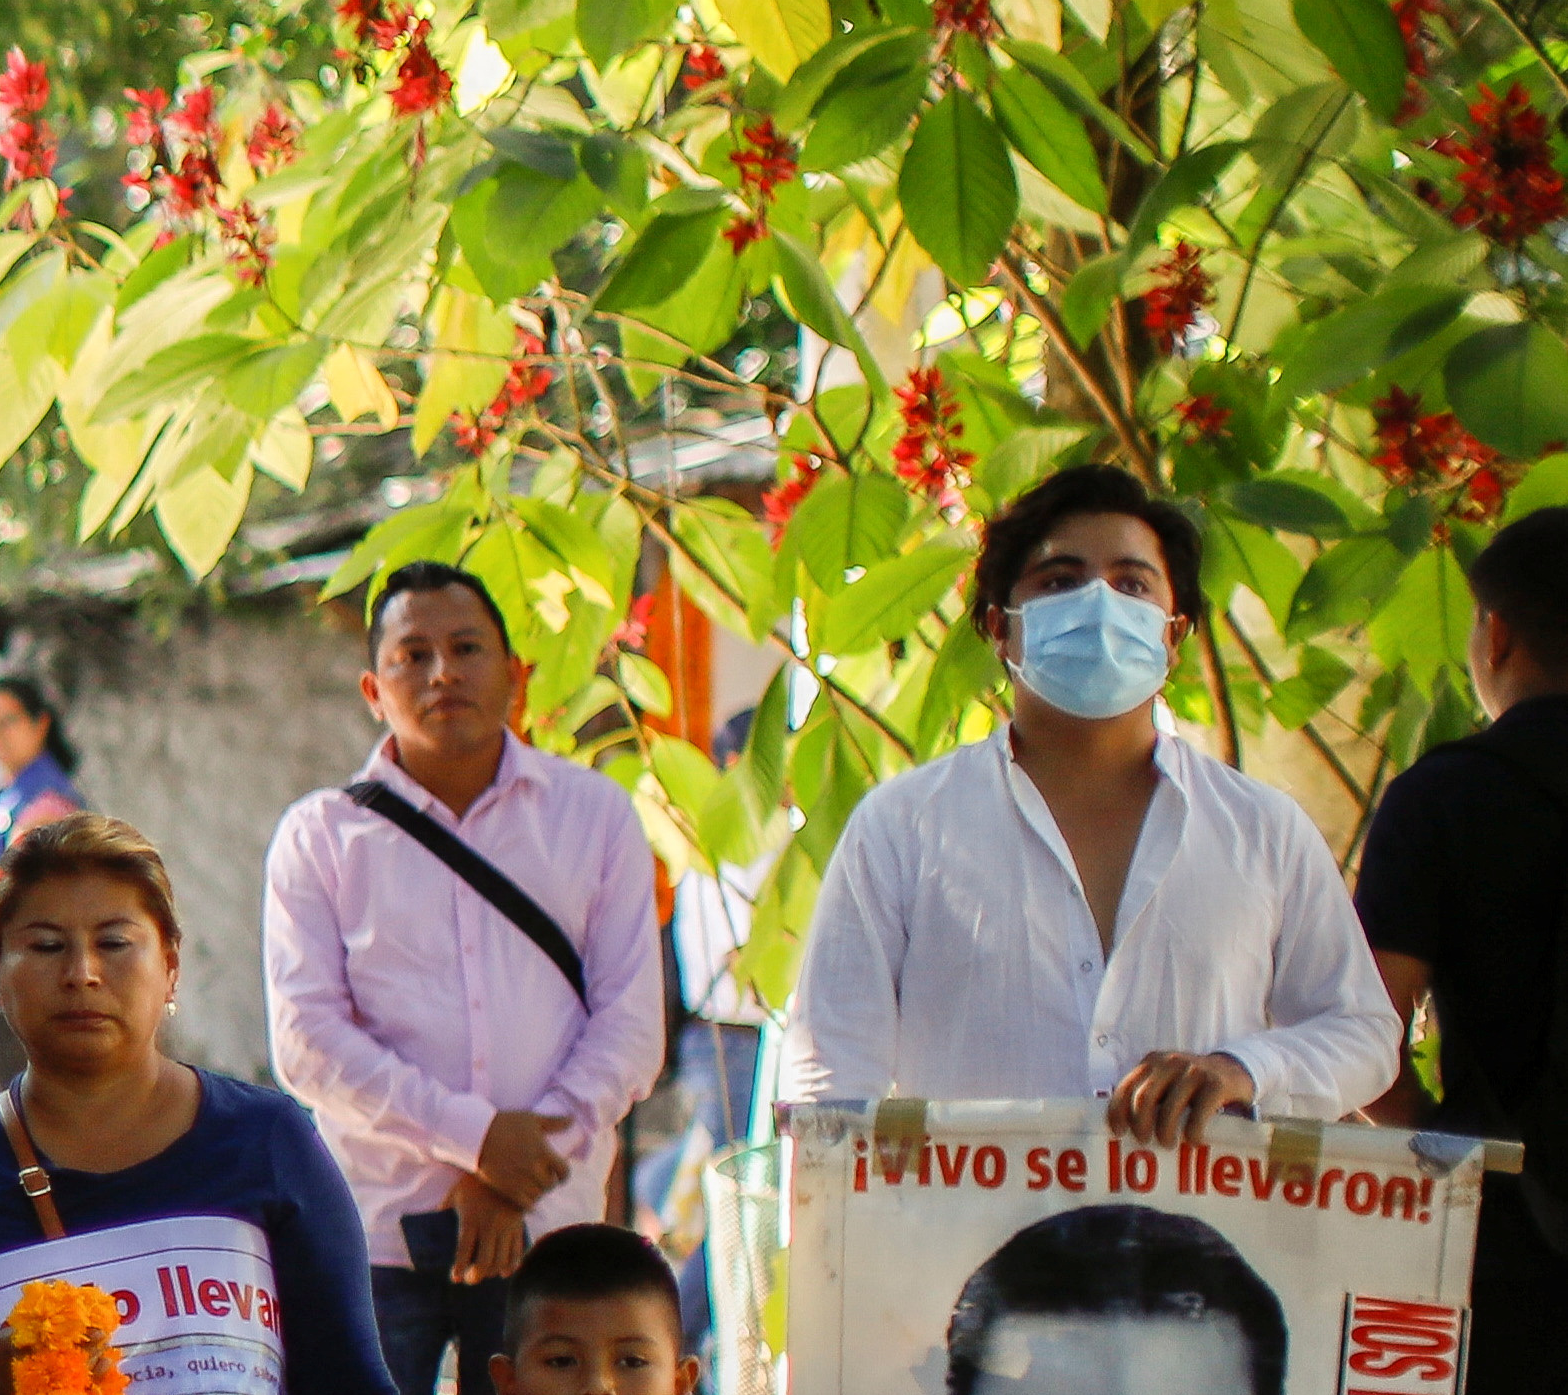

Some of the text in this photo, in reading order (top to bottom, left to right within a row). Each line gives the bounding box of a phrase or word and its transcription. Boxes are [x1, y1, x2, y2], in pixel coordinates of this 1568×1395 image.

[853, 1137, 1433, 1223] ¡Vivo se lo llevaron!
[1349, 1295, 1458, 1382] NOS
